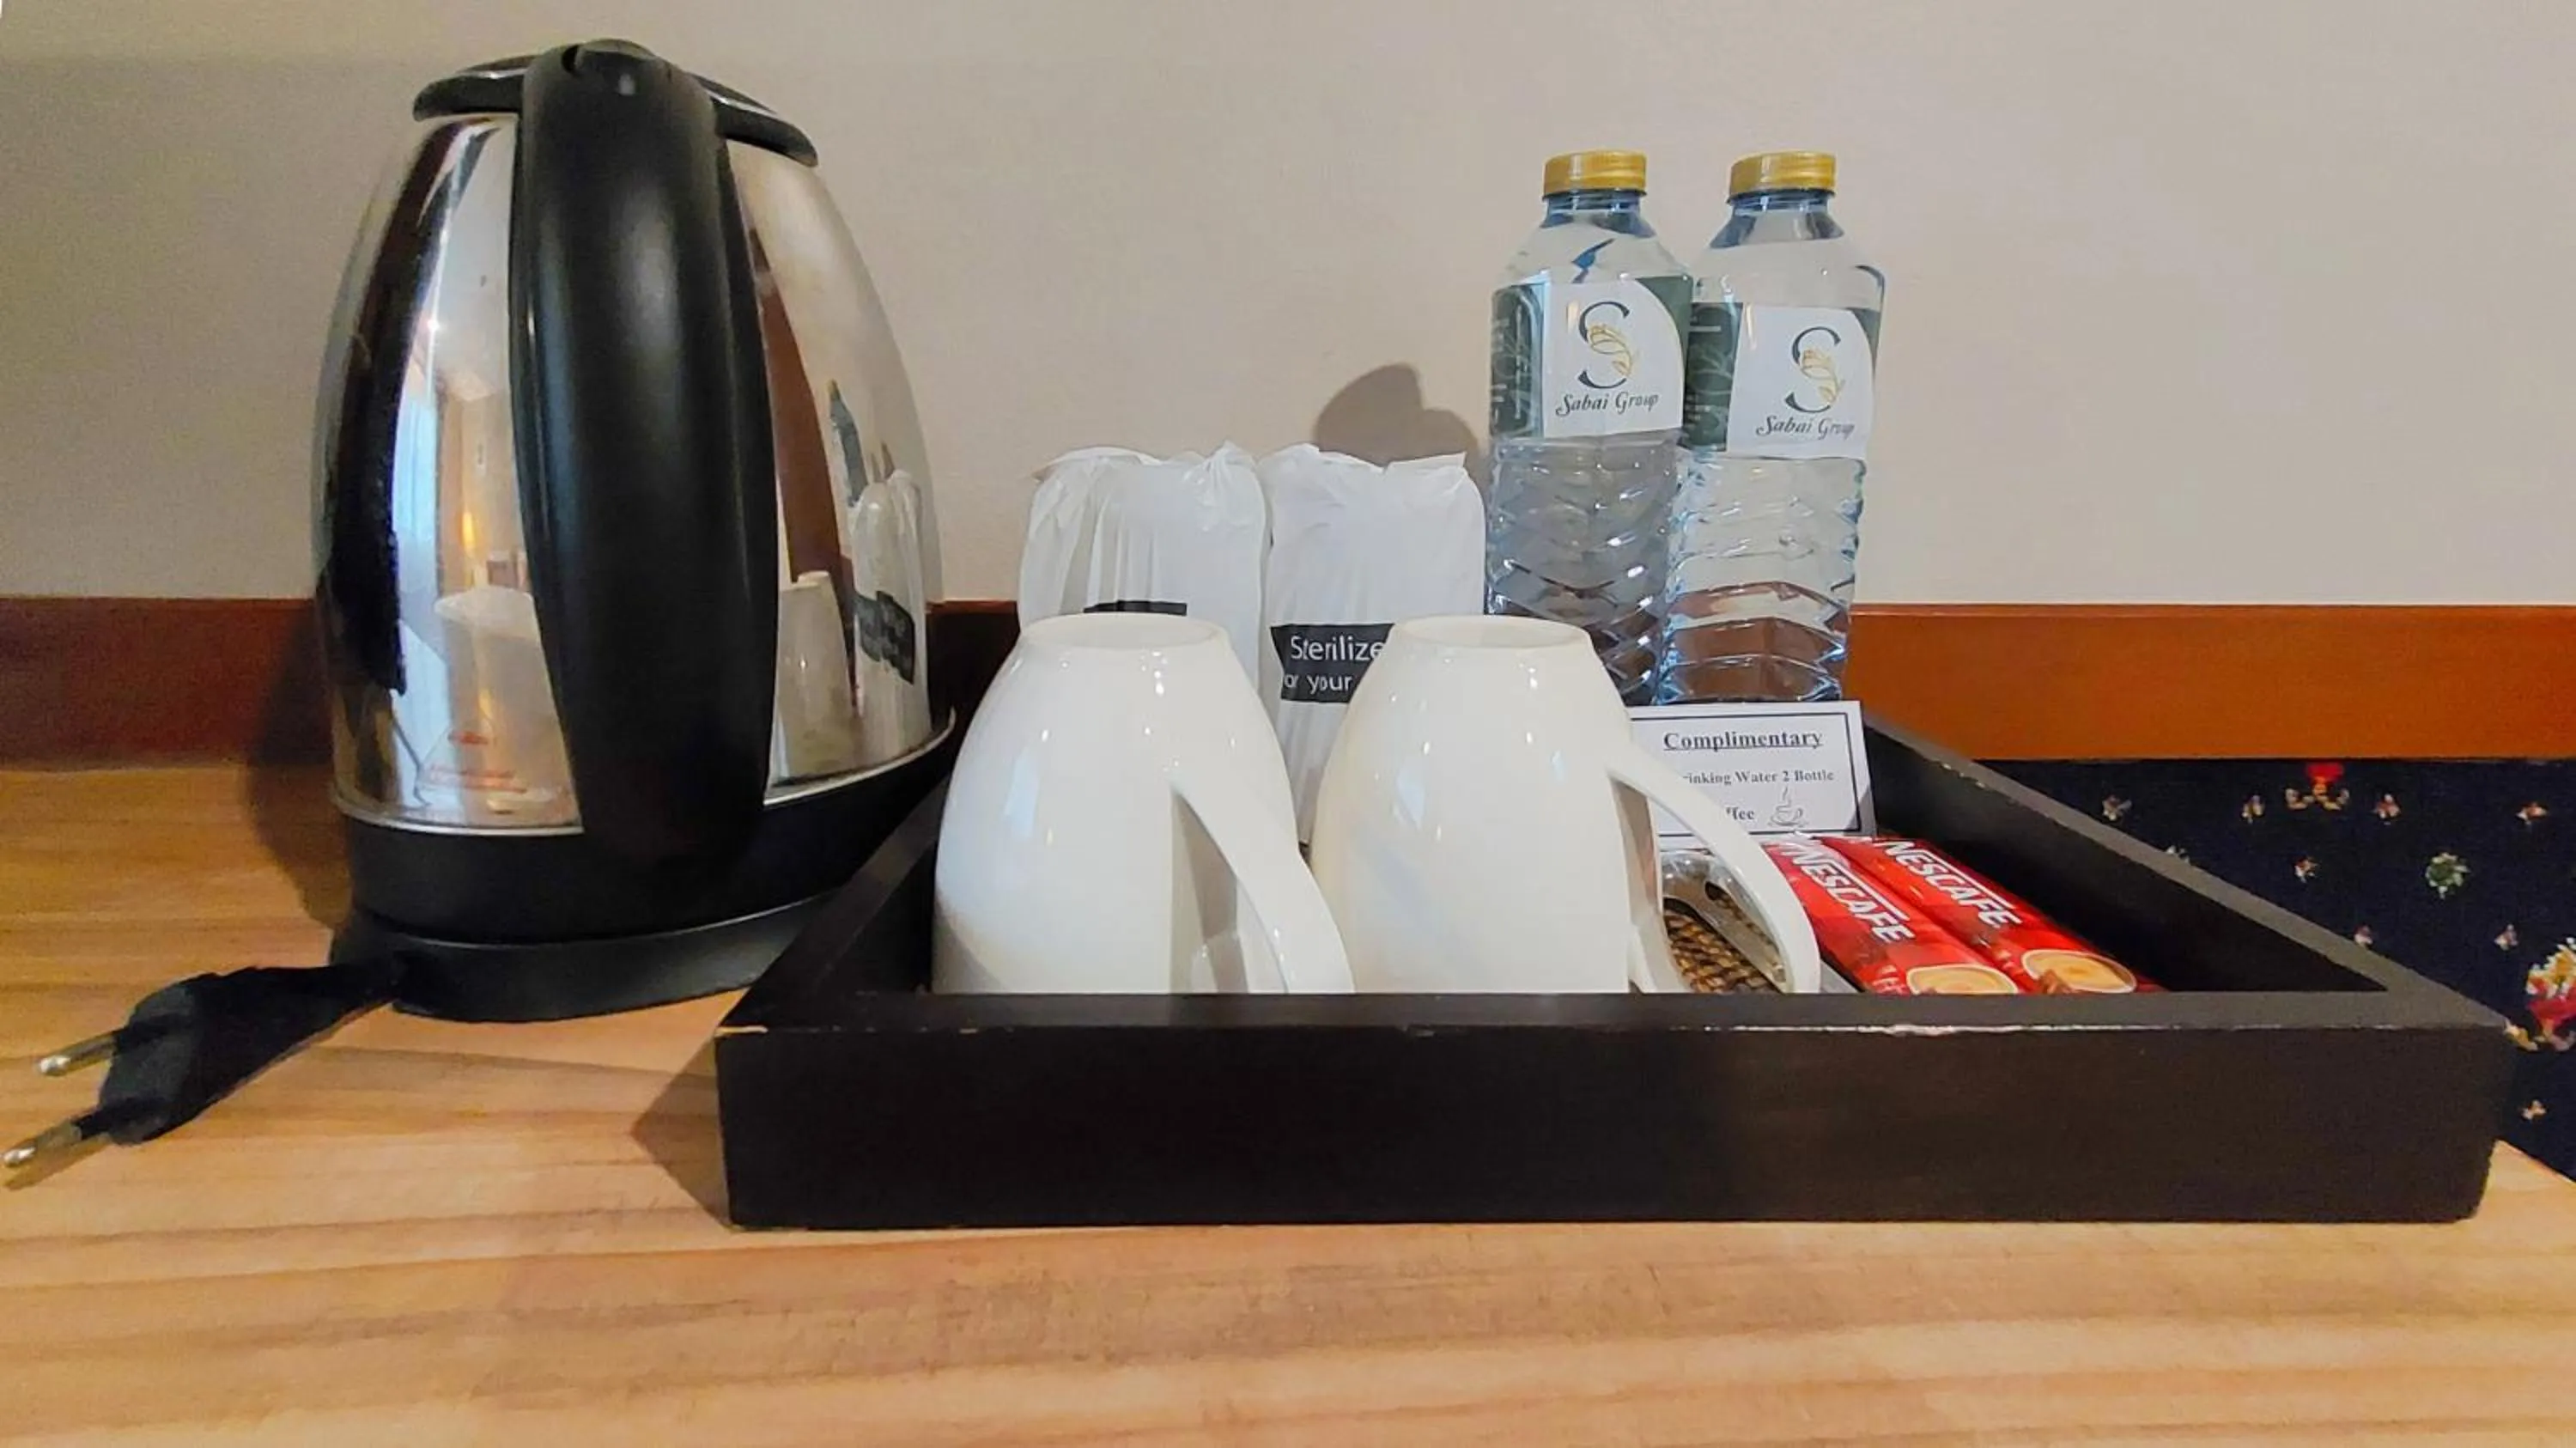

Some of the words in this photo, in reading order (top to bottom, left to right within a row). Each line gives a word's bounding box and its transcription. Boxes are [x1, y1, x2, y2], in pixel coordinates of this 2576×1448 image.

[1555, 392, 1610, 417] Sabai
[1615, 391, 1659, 415] Group
[1755, 415, 1815, 436] Sabai
[1291, 635, 1387, 660] Sterilize
[1284, 673, 1299, 688] or
[1306, 674, 1353, 695] your
[1663, 731, 1823, 752] Complimentary
[1683, 772, 1732, 785] inking
[1735, 770, 1777, 782] Water
[1783, 770, 1790, 782] 2
[1794, 770, 1834, 781] Bottle
